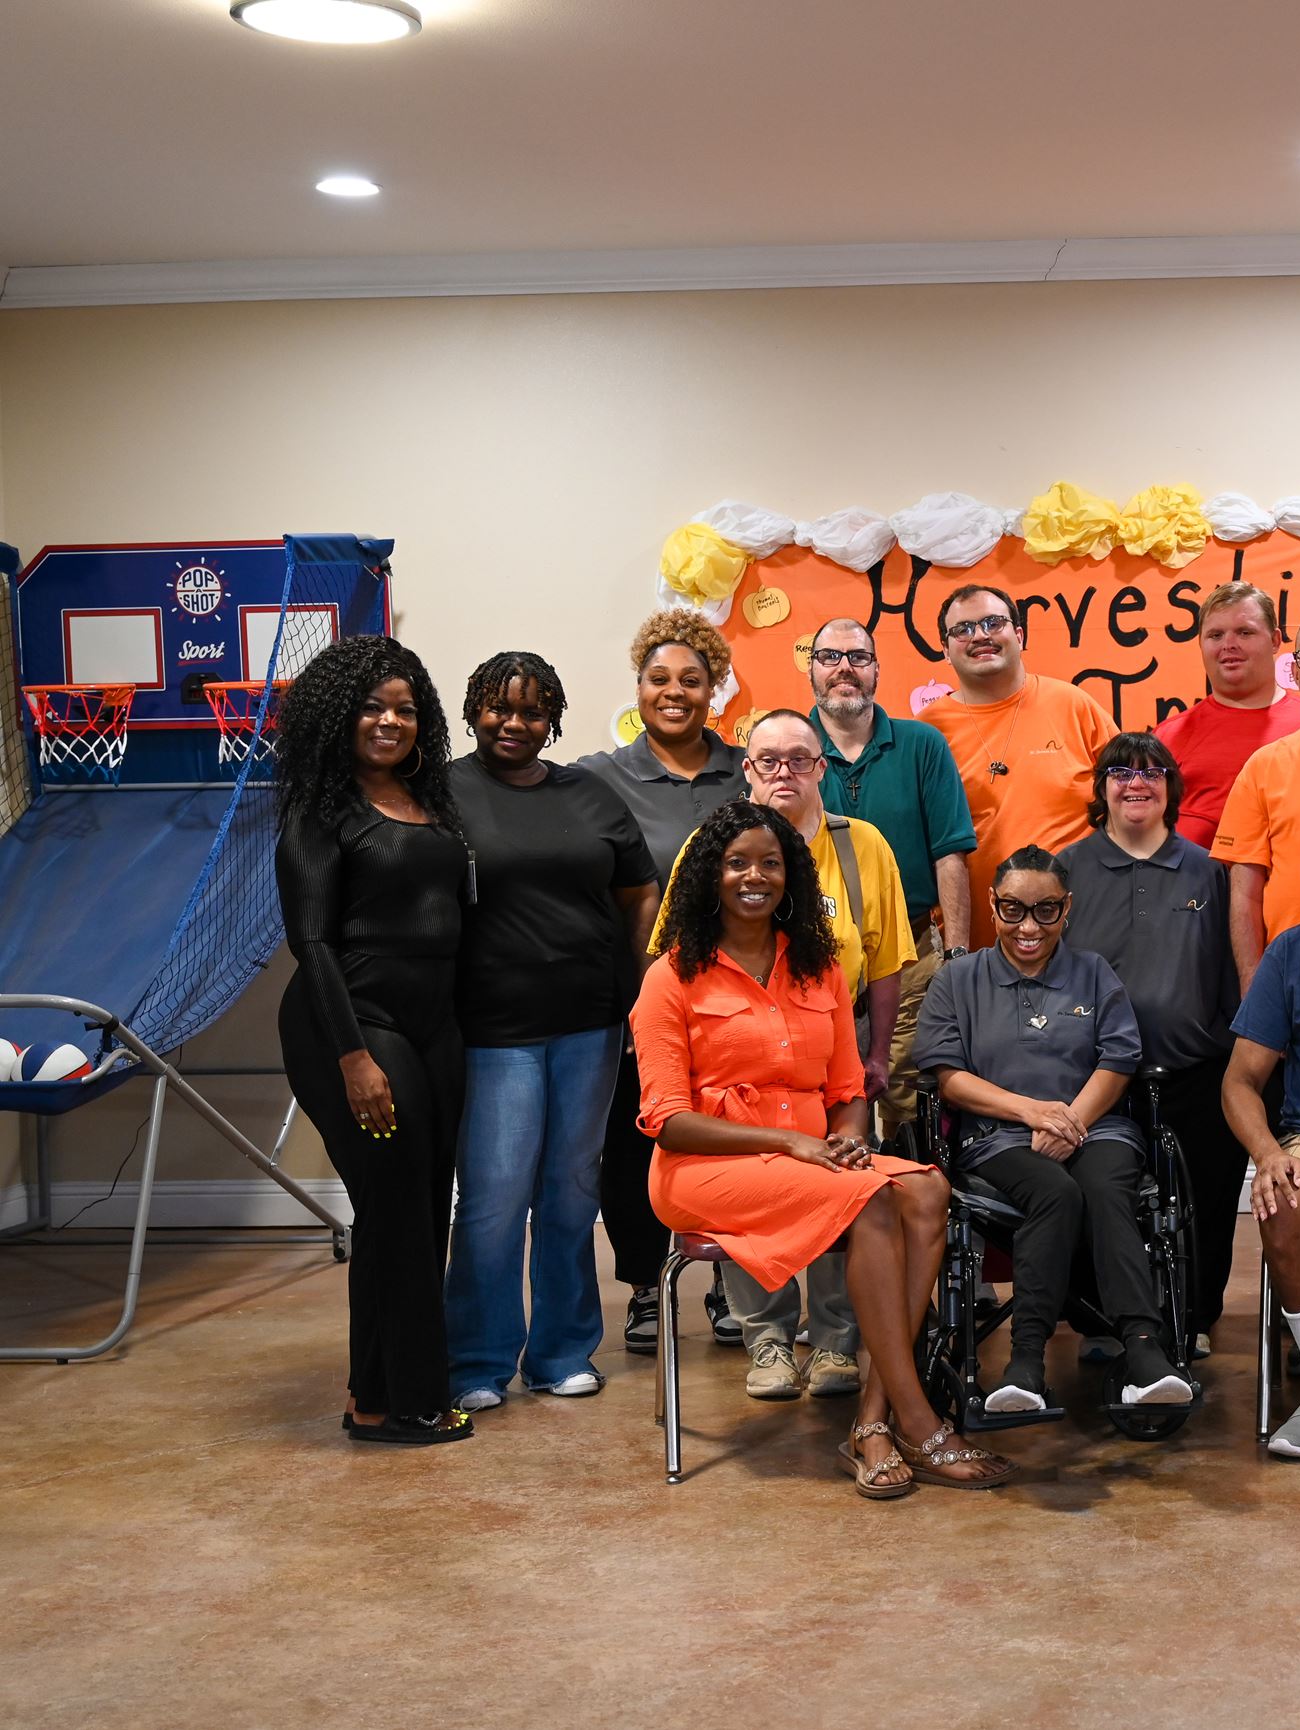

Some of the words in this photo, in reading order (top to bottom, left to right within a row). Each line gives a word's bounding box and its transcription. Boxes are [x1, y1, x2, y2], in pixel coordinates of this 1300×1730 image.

[182, 569, 215, 588] POP
[183, 593, 215, 612] SHOT
[178, 640, 225, 660] Sport
